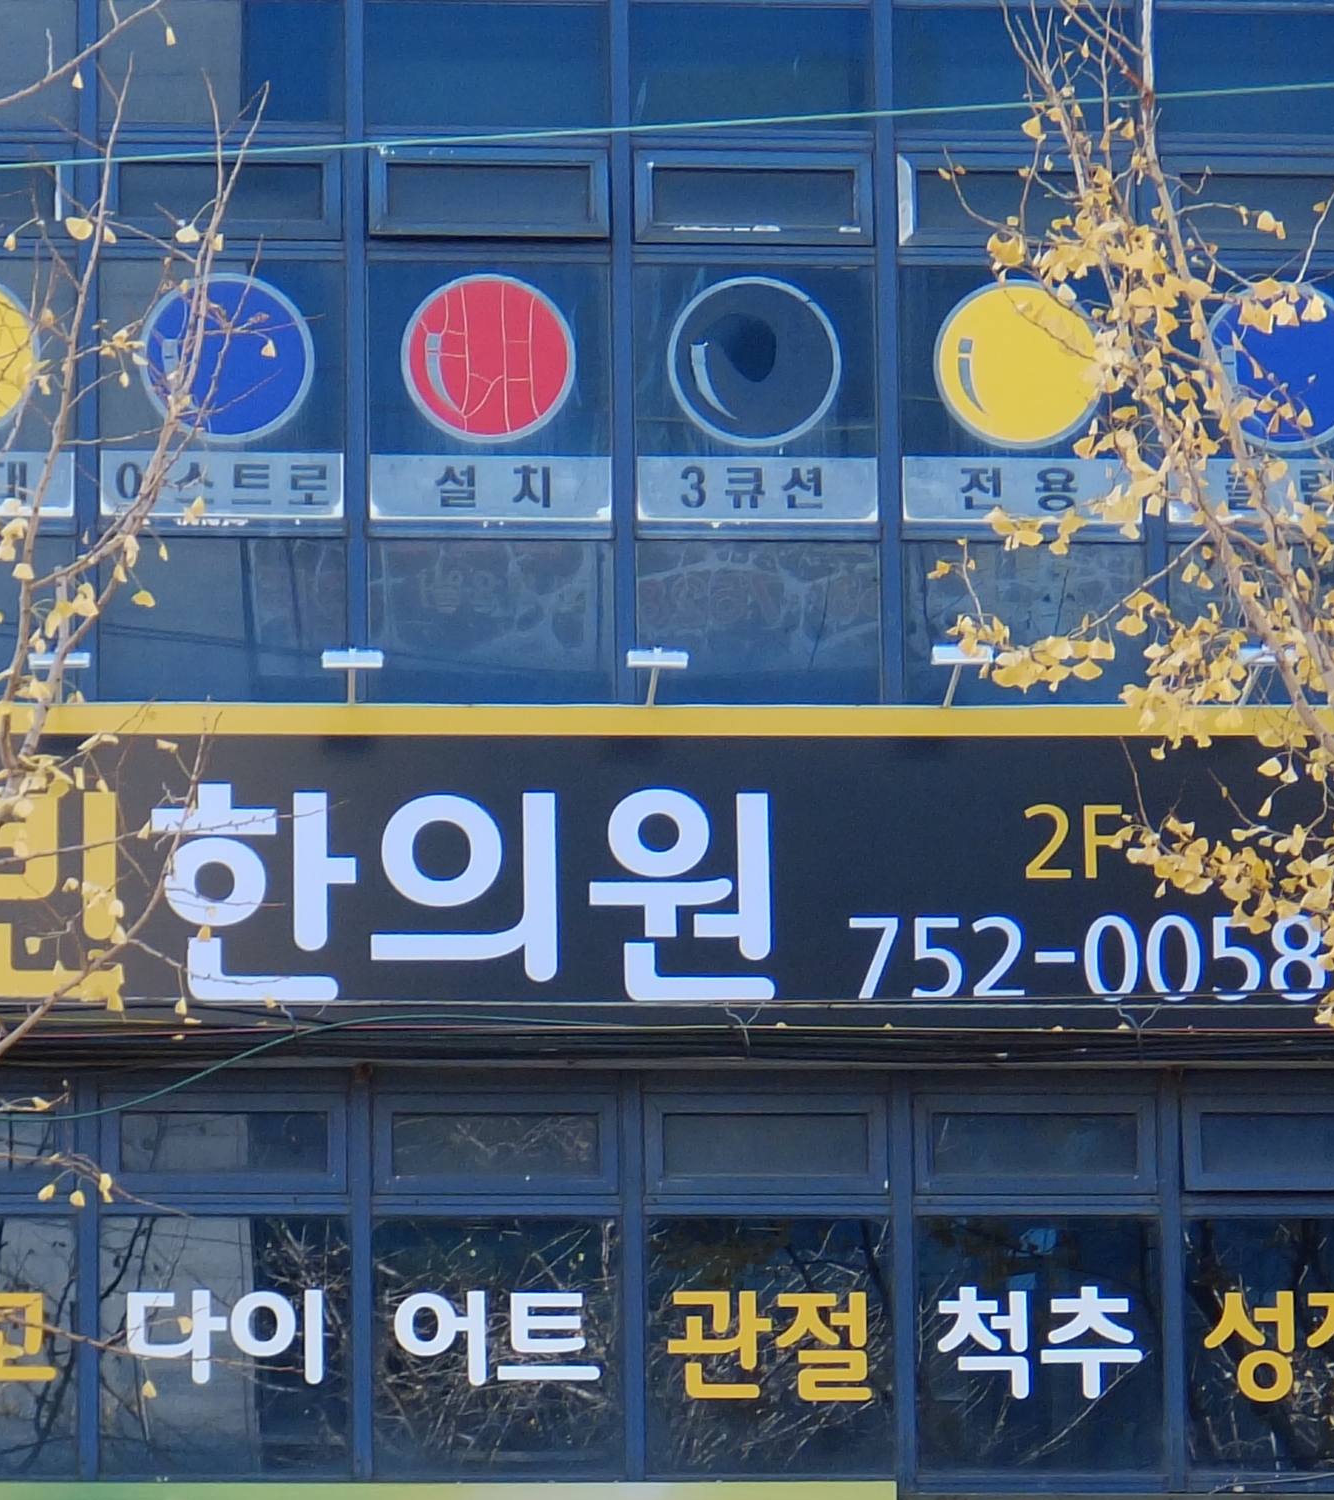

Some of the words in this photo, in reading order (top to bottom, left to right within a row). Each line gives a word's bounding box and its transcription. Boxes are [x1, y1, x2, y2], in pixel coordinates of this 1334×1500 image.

[435, 464, 552, 509] 설치
[680, 465, 825, 511] 3큐션
[959, 466, 1079, 511] 전용
[1023, 802, 1124, 881] 2F
[847, 913, 1331, 1001] 752-0058
[667, 1290, 873, 1403] 관절
[936, 1284, 1145, 1400] 척추
